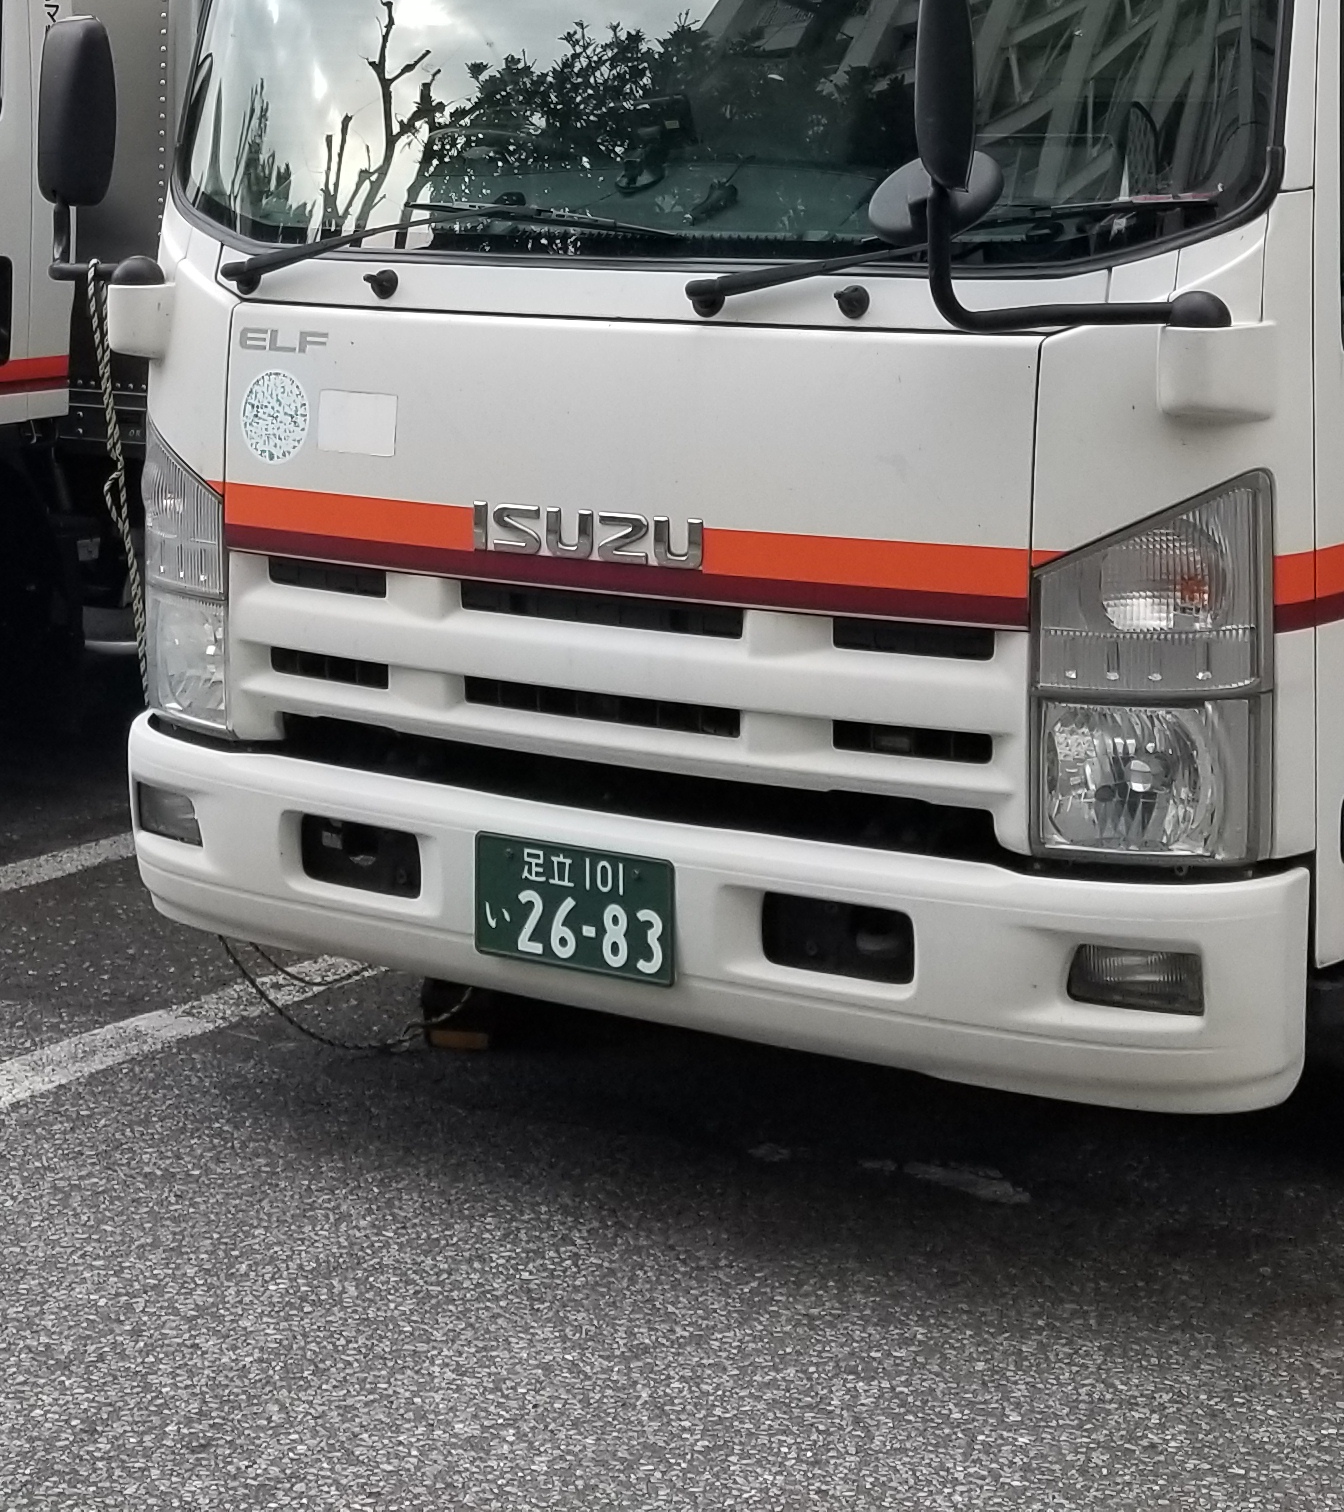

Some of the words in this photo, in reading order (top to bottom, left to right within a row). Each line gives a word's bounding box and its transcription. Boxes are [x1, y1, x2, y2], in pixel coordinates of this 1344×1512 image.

[239, 327, 329, 354] ELF
[472, 499, 704, 570] ISUZU
[522, 848, 575, 887] 足立
[585, 857, 624, 896] 101
[485, 900, 511, 929] い
[517, 890, 663, 974] 26-83
